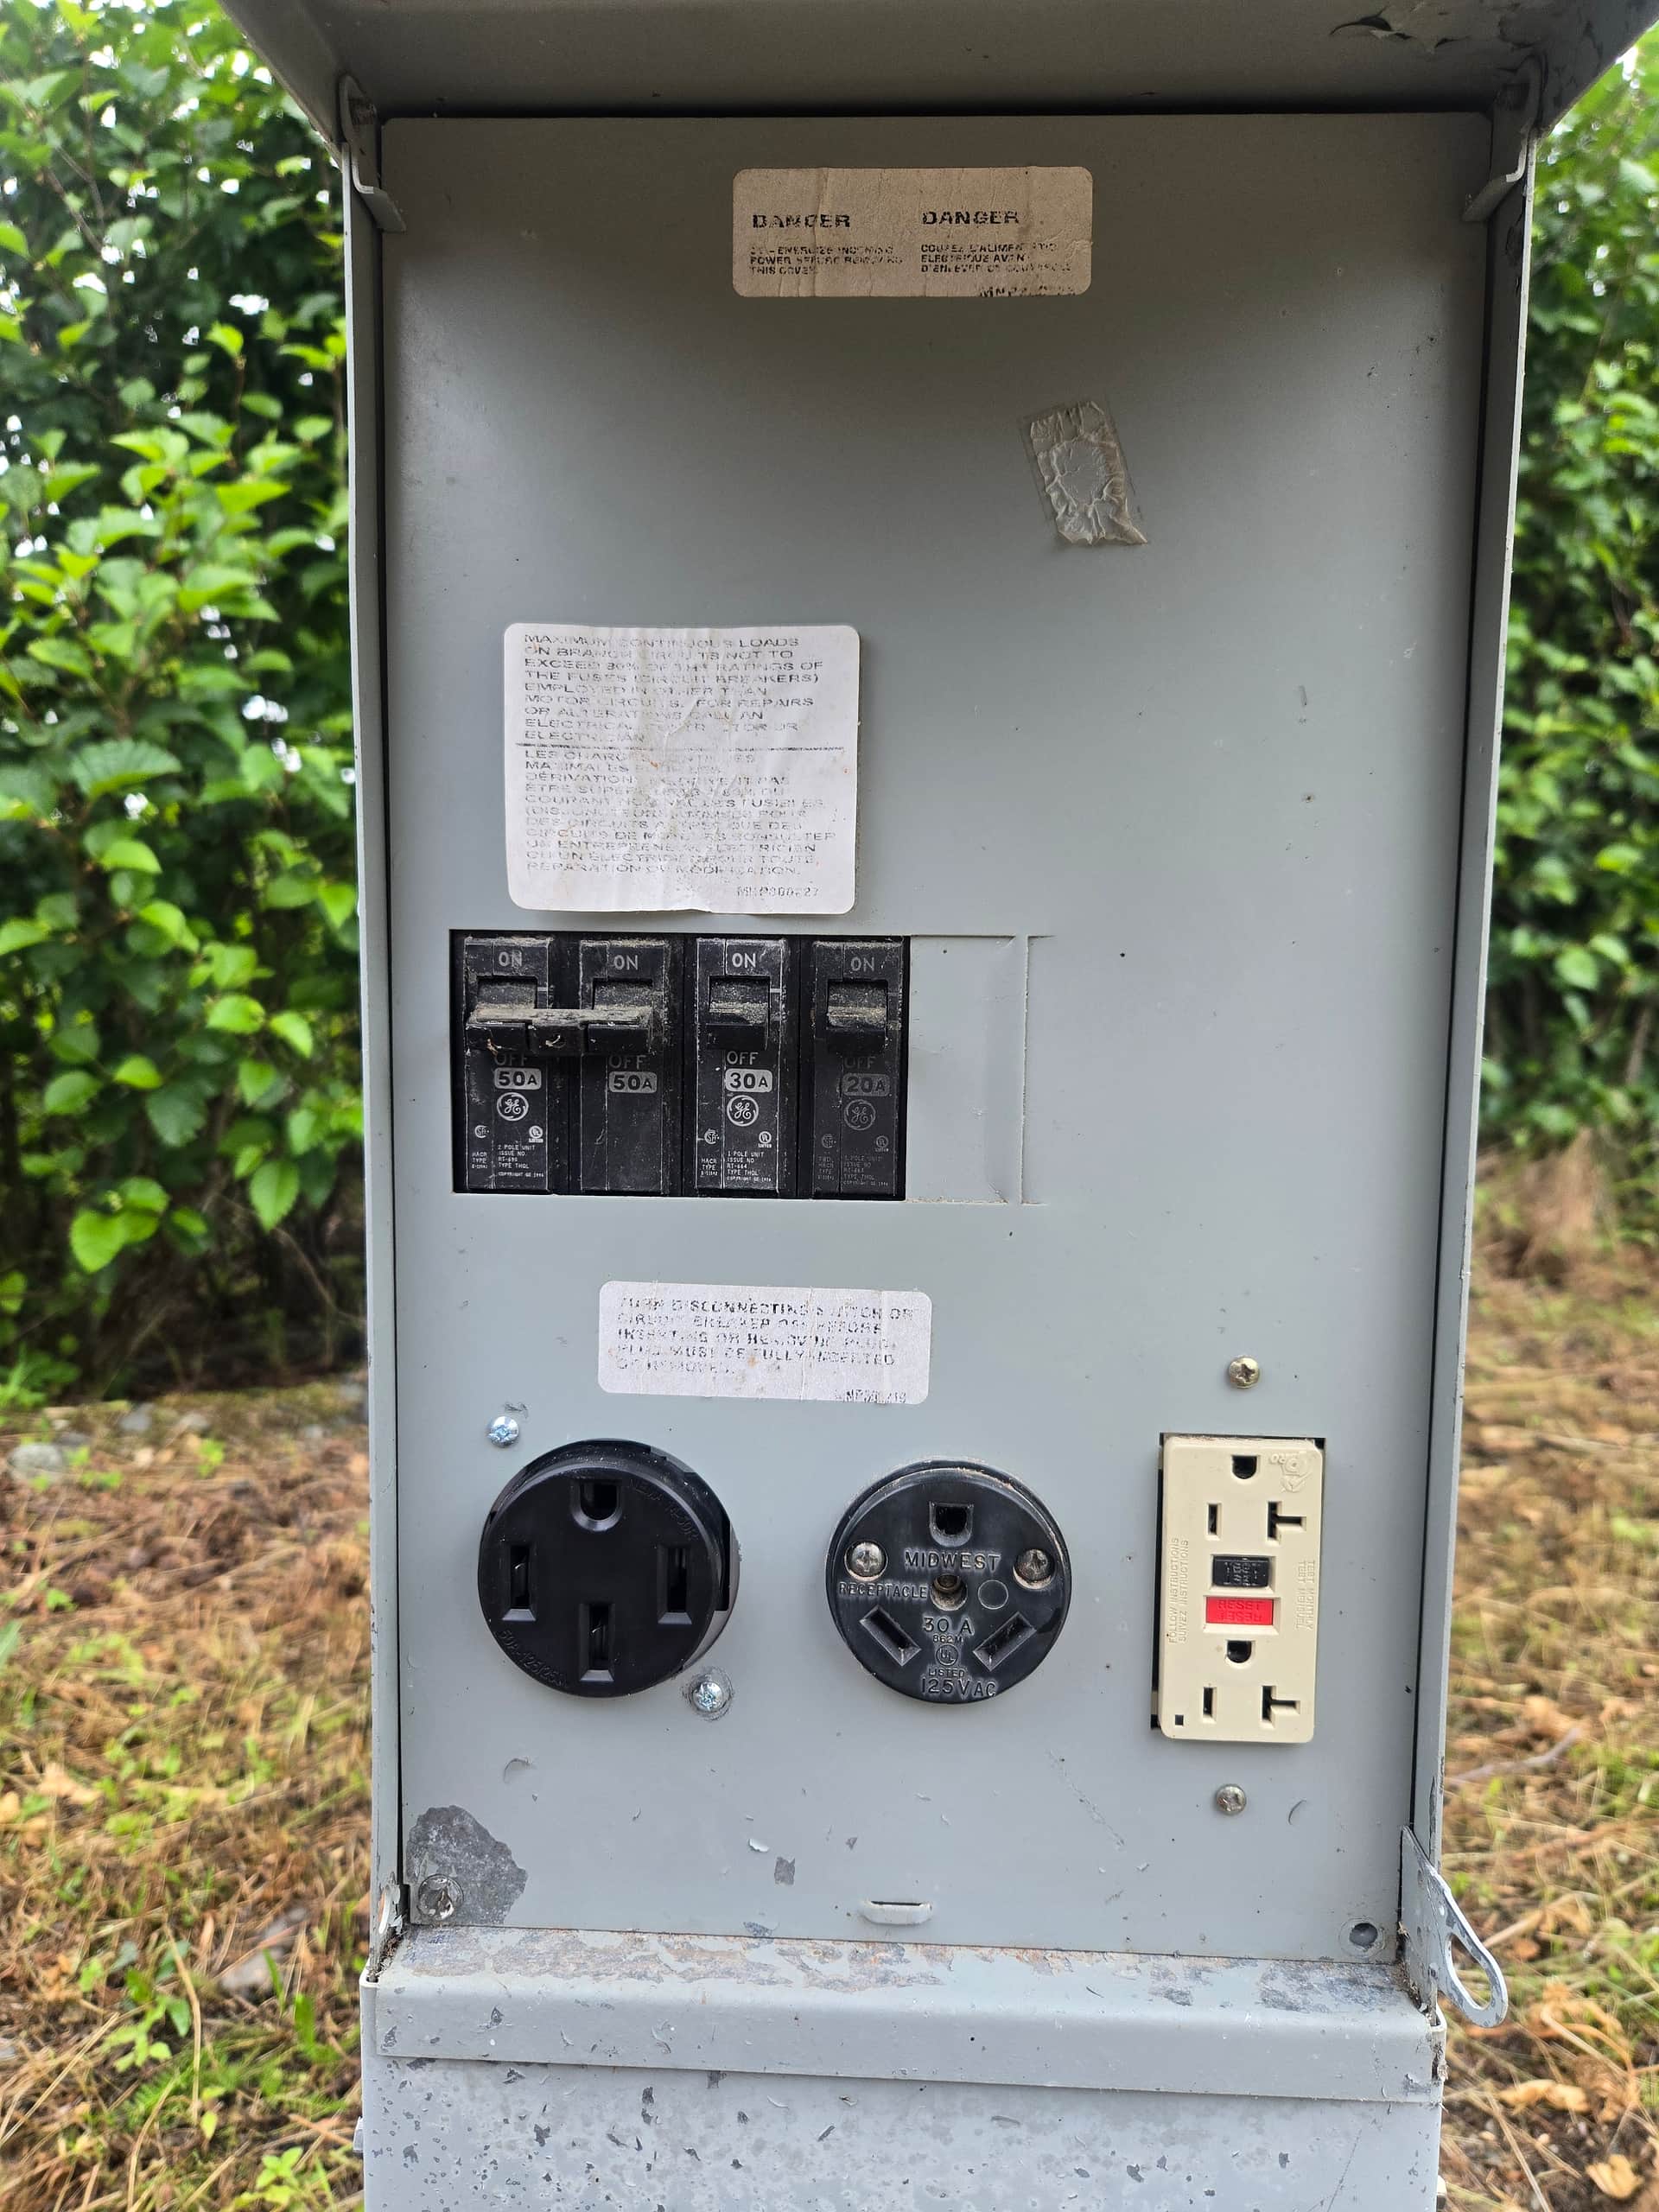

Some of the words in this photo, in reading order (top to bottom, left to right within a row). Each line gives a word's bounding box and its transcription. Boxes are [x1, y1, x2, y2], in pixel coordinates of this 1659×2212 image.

[922, 211, 1020, 225] DANGER
[740, 638, 799, 647] LOADS
[727, 650, 761, 659] NOT
[770, 650, 793, 658] TO
[801, 661, 823, 670] OF
[525, 671, 560, 680] THE
[499, 951, 522, 967] ON
[613, 955, 639, 970] ON
[732, 952, 756, 969] ON
[850, 957, 874, 972] ON
[608, 1054, 647, 1069] OFF
[727, 1051, 759, 1065] OFF
[499, 1071, 537, 1087] 50A
[613, 1075, 652, 1091] 50A
[729, 1073, 768, 1089] 30A
[847, 1077, 886, 1094] 20A
[906, 1551, 1001, 1571] MIDWEST
[1170, 1537, 1179, 1603] INSTRUCTIONS
[1179, 1540, 1189, 1605] INSTRUCTIONS
[839, 1582, 928, 1599] RECEPTACLE
[1217, 1599, 1265, 1611] RESET
[1169, 1607, 1178, 1643] FOLLOW
[1178, 1610, 1187, 1643] SUIVEZ
[928, 1668, 965, 1677] LISTED
